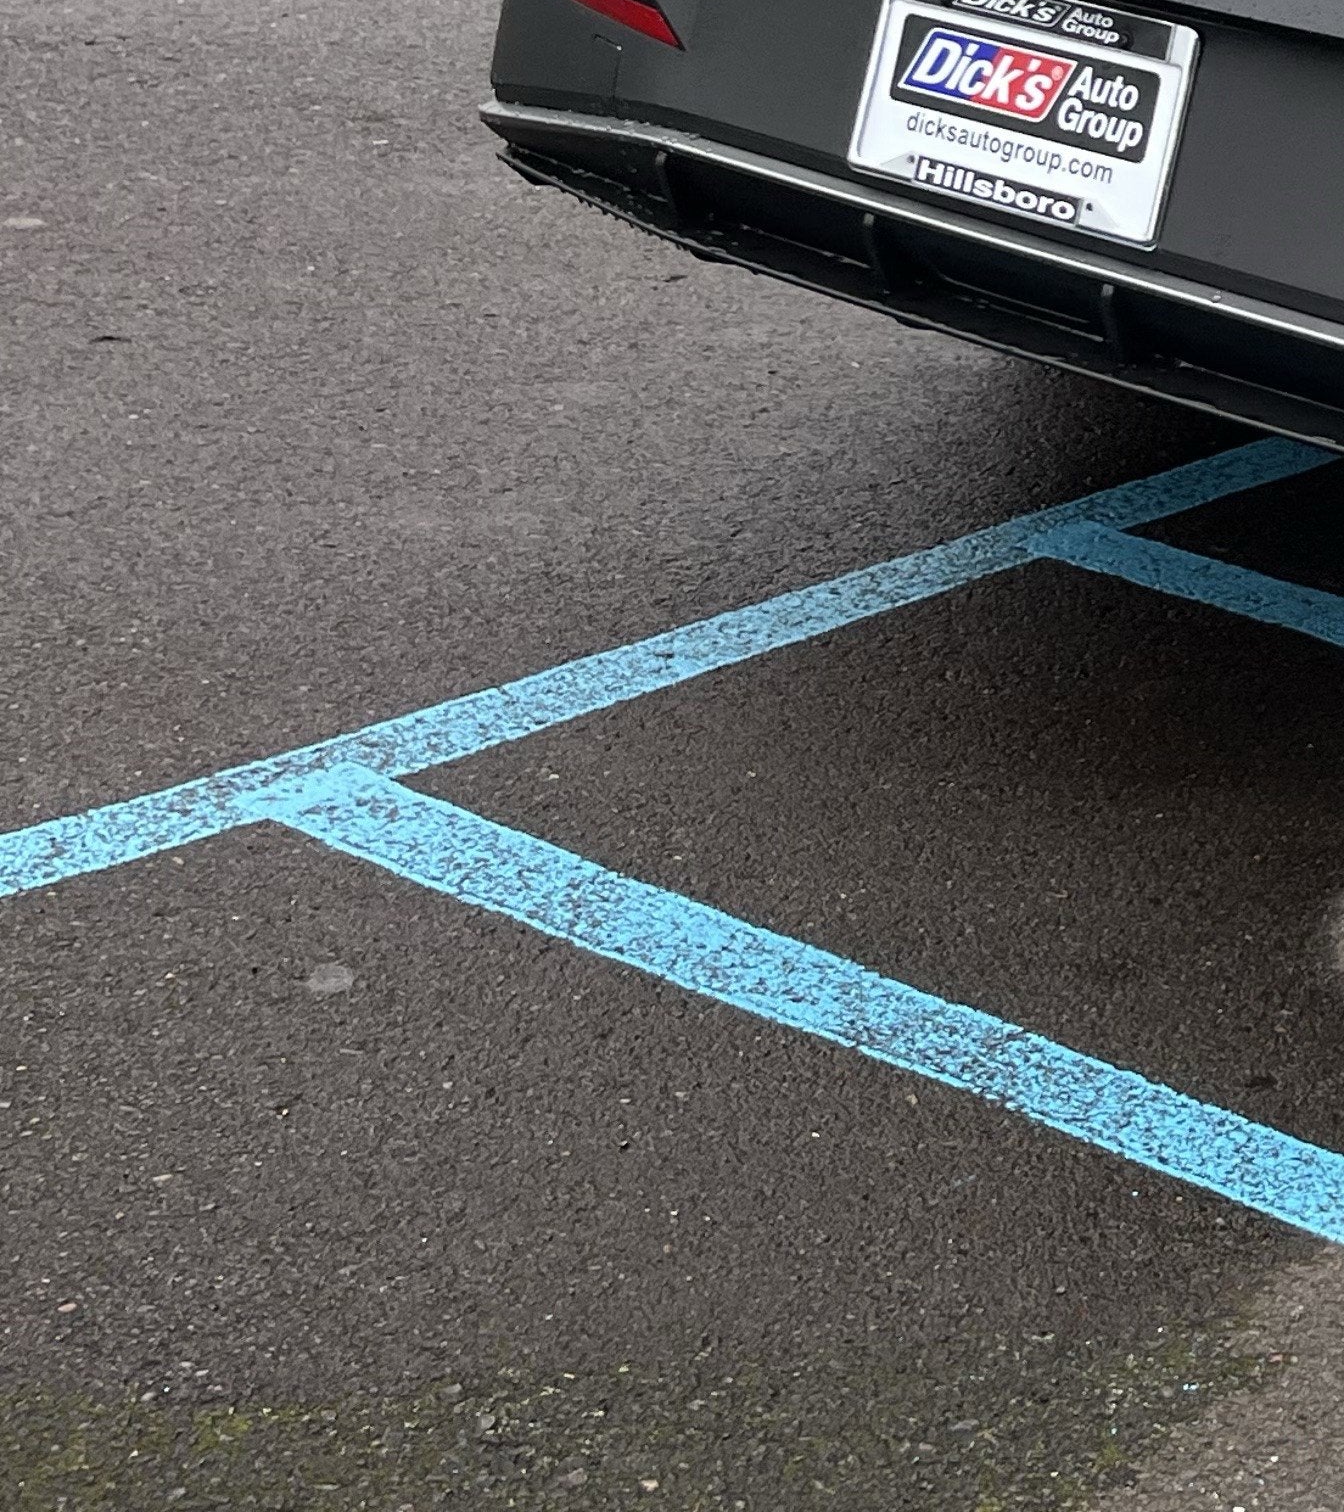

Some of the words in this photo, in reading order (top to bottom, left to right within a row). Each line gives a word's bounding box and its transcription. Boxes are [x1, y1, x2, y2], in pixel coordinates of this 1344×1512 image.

[1062, 18, 1121, 45] Group
[1069, 7, 1114, 29] Auto
[911, 37, 1053, 113] Dick's
[1067, 66, 1140, 112] Auto
[906, 111, 1114, 185] dicksautogroup.com
[1057, 97, 1144, 153] Group
[916, 158, 1076, 221] Hillsboro
